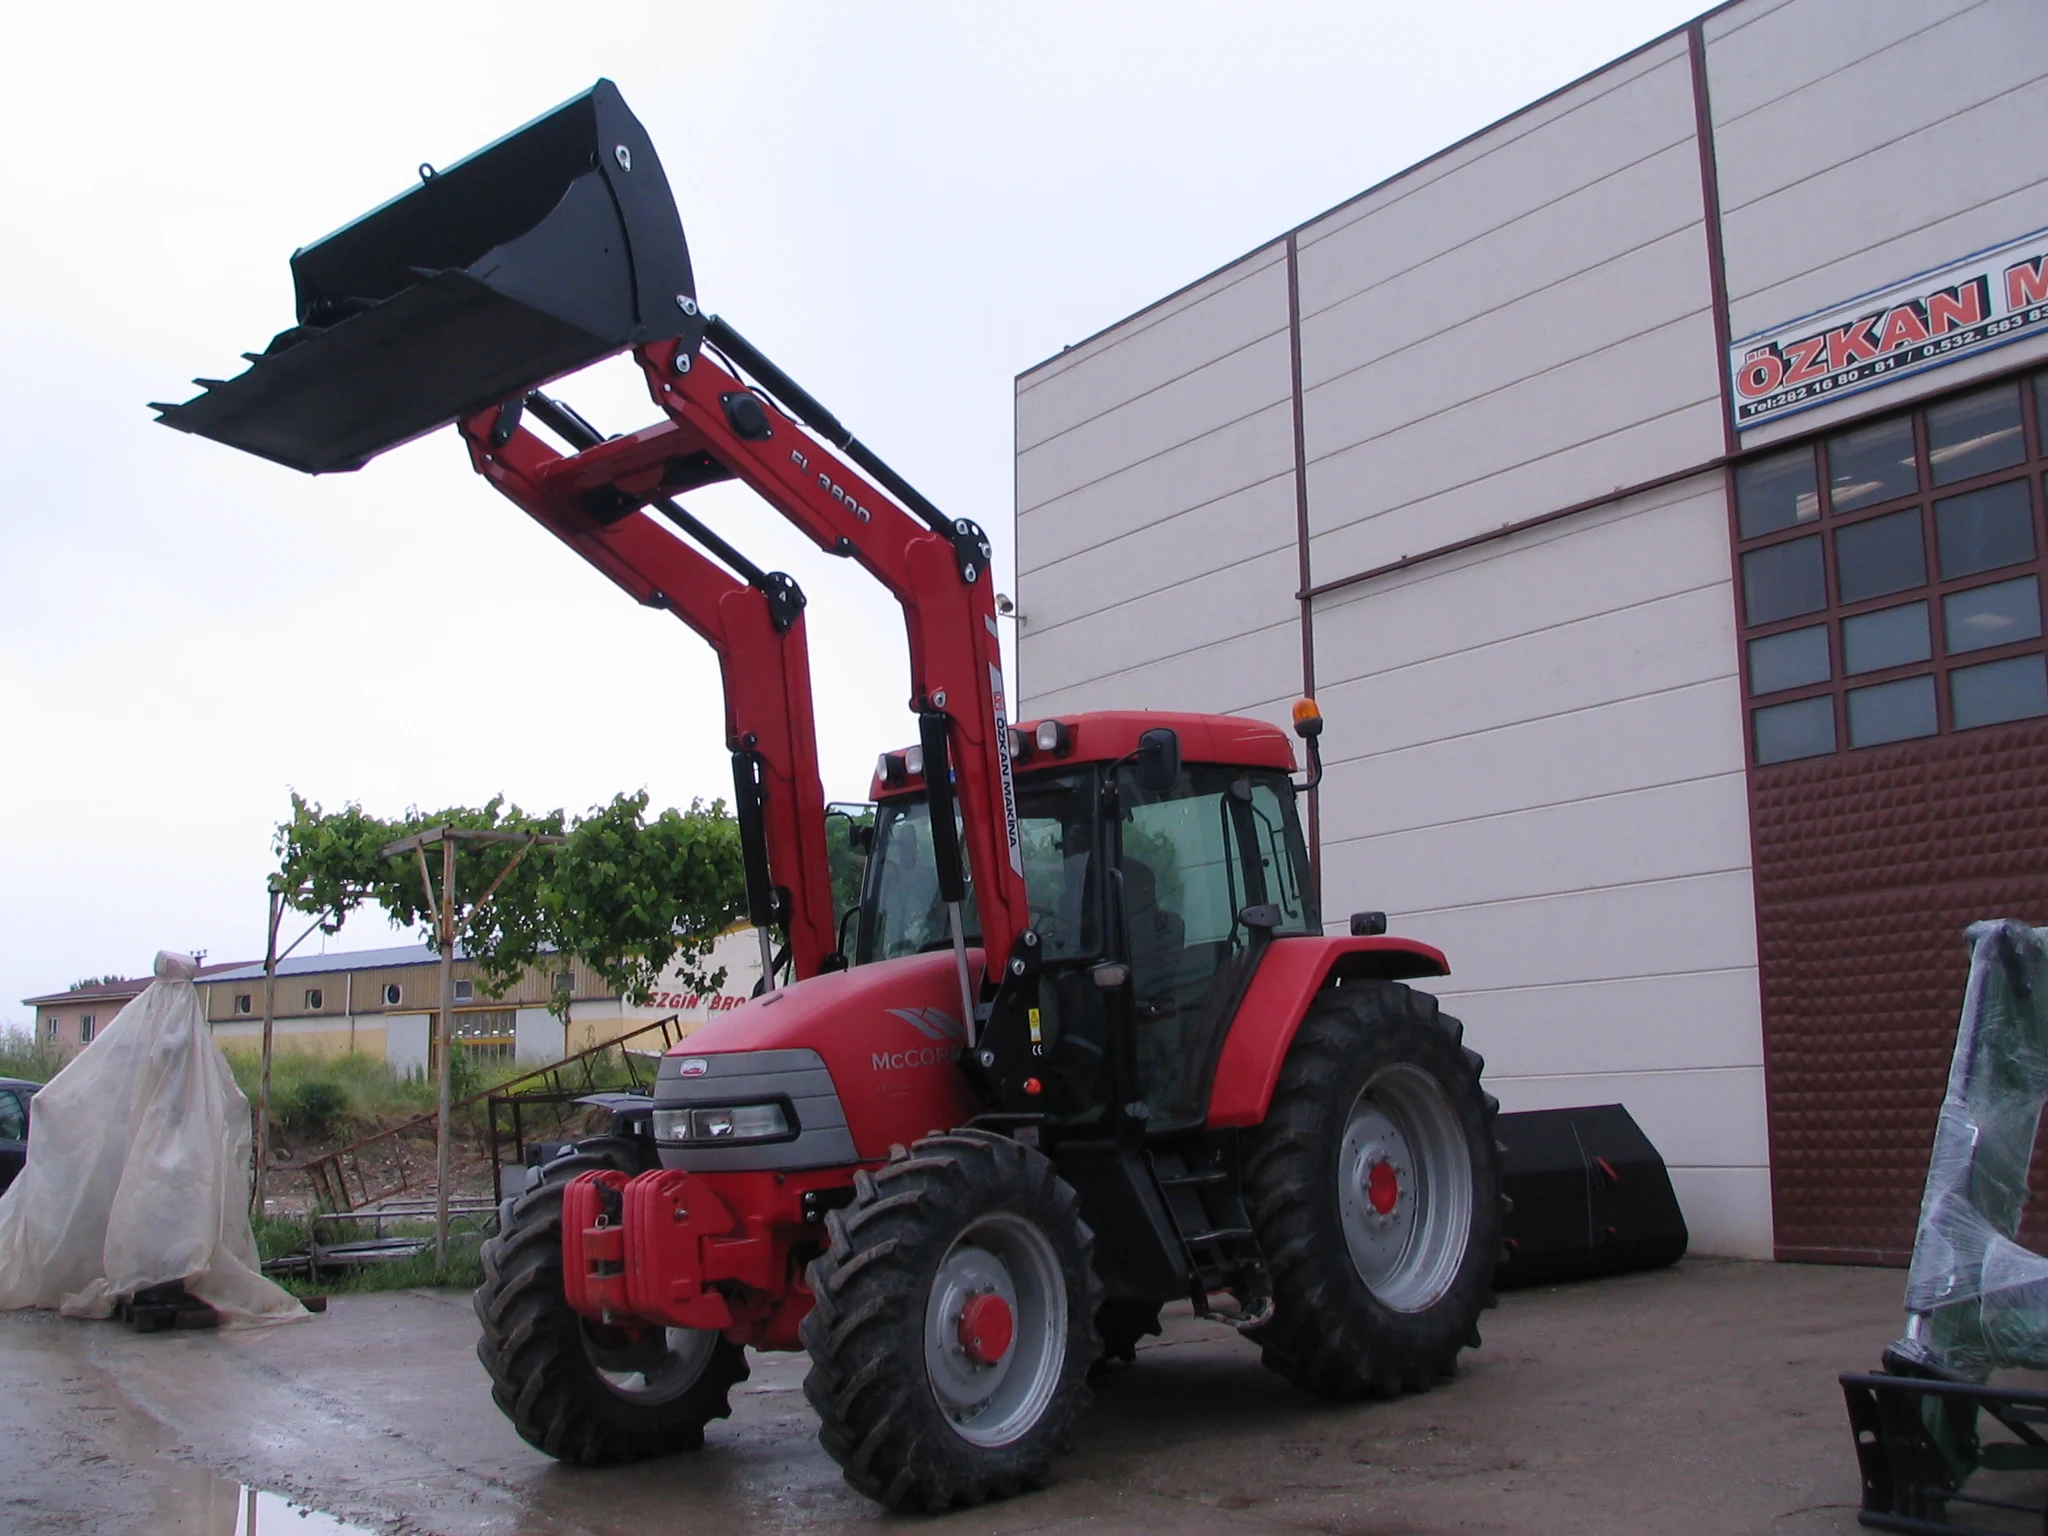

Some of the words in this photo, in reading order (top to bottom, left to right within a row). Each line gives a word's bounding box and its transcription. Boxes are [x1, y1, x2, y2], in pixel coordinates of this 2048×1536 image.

[1736, 276, 1989, 398] ÖZKAN
[1747, 388, 1807, 414] Tel:282
[1812, 379, 1832, 393] 16
[1838, 371, 1858, 384] 80
[1874, 358, 1895, 372] 81
[1987, 317, 2023, 336] 583
[790, 449, 811, 476] FL
[818, 472, 871, 524] 3800
